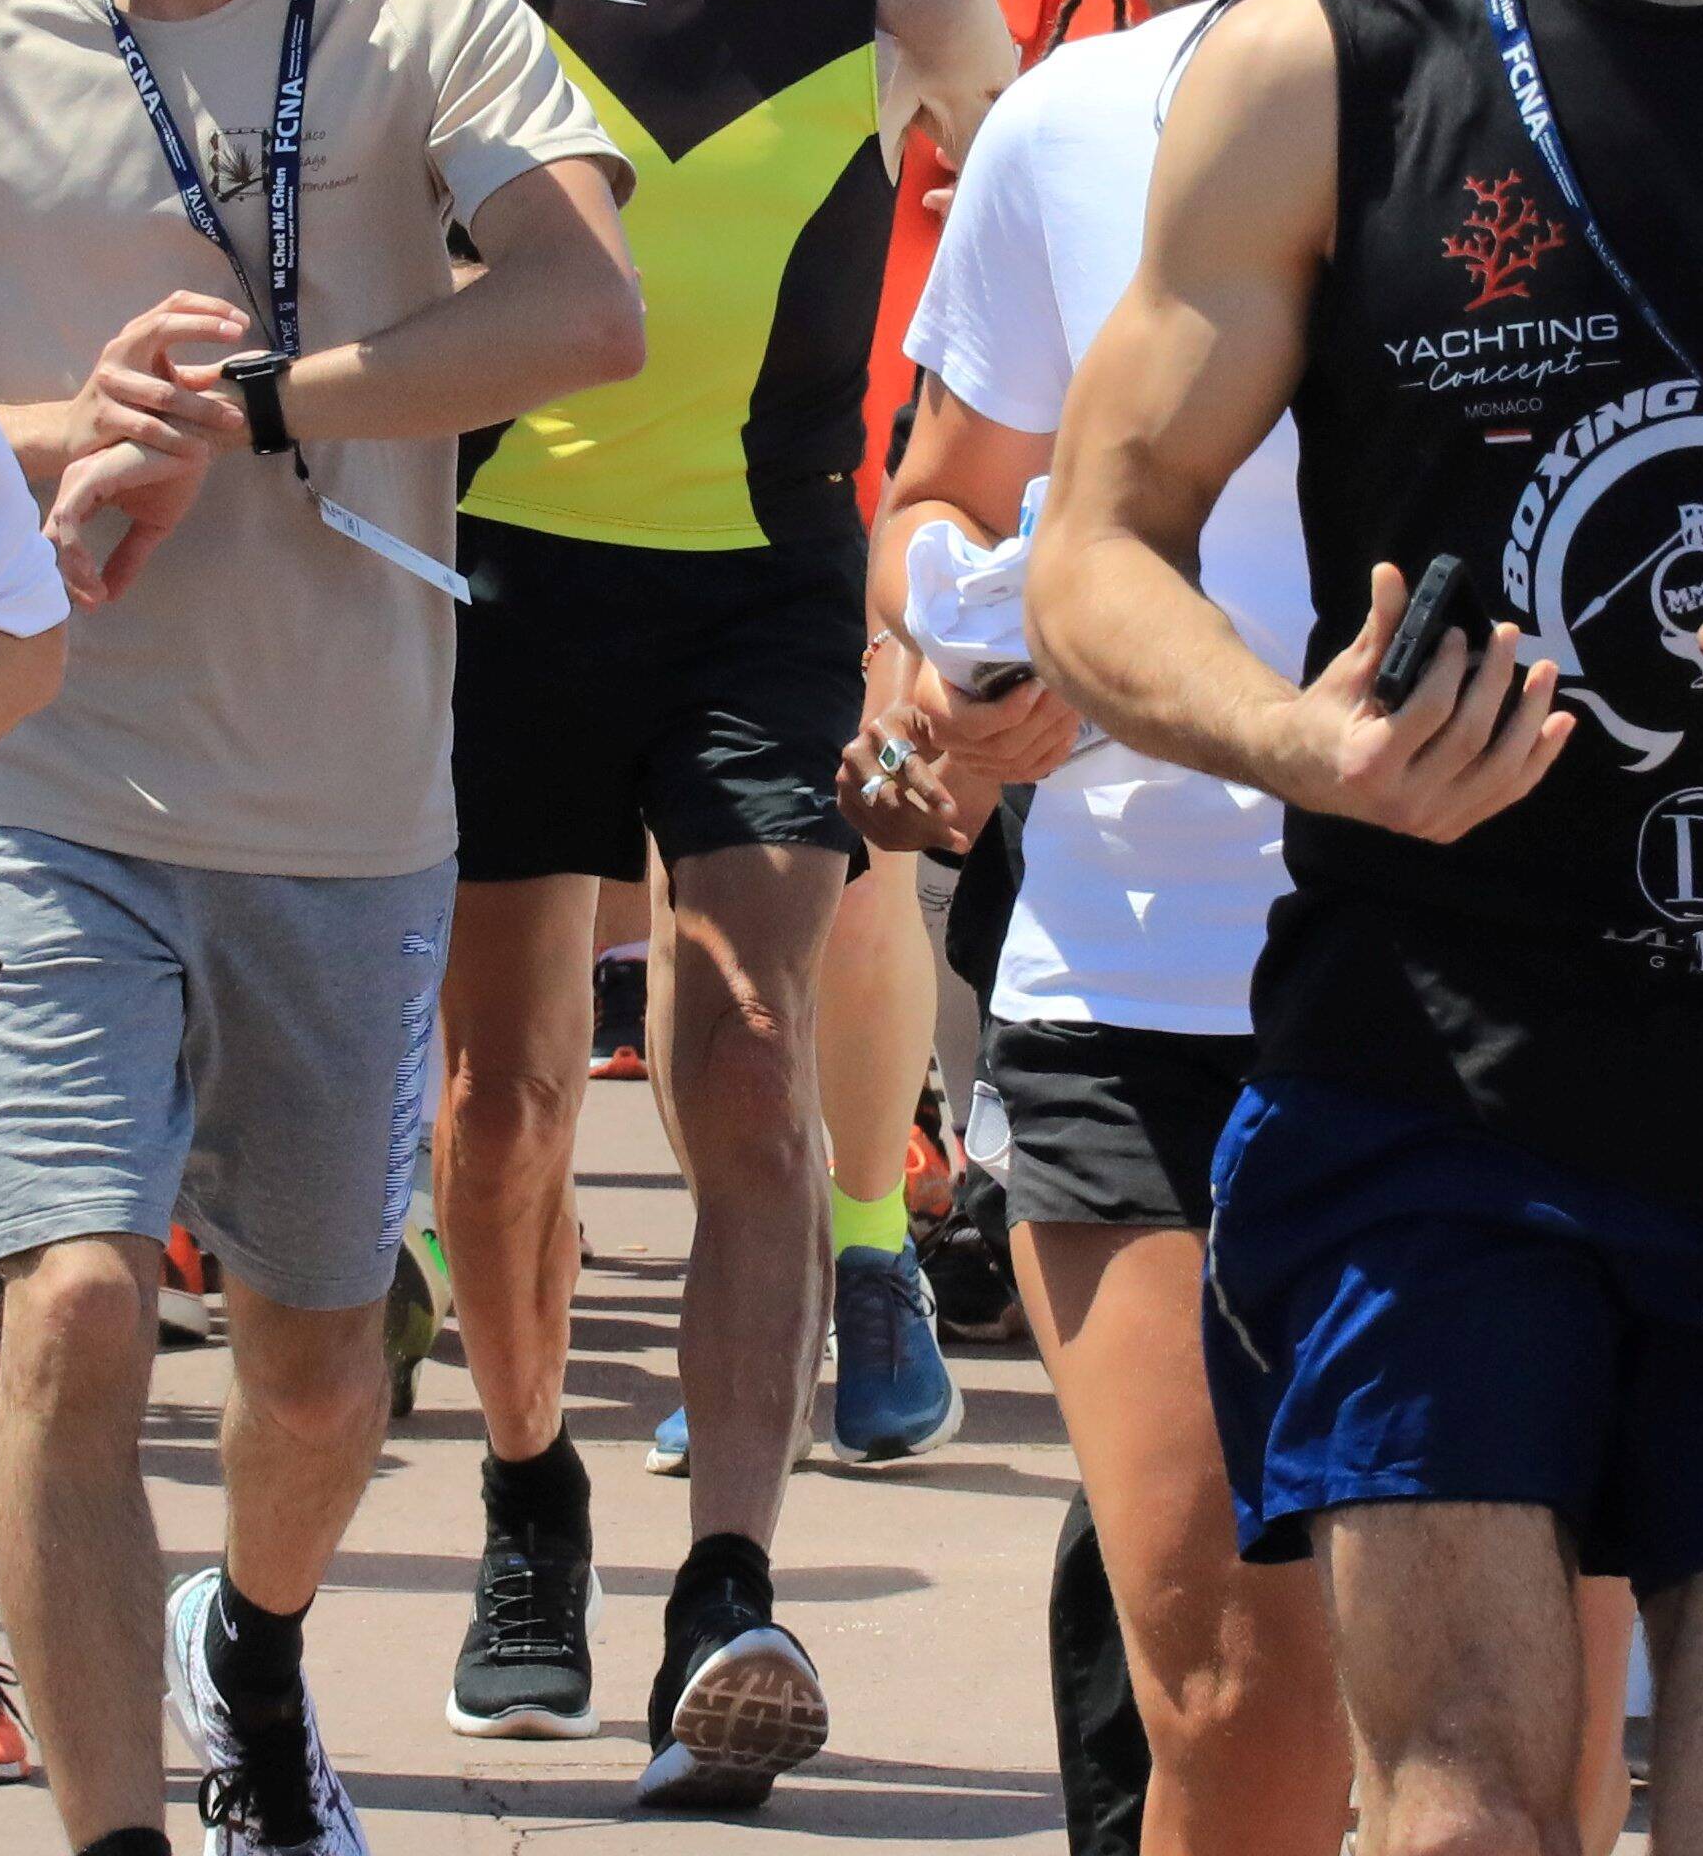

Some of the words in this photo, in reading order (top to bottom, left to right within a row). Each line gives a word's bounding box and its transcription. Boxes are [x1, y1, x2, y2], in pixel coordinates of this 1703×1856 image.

[119, 36, 161, 114] FCNA
[1502, 41, 1550, 142] FCNA
[275, 77, 303, 153] FCNA
[273, 166, 286, 207] Chien
[273, 209, 285, 229] Mi
[273, 231, 285, 266] Chat
[273, 268, 286, 289] Mi
[1383, 313, 1620, 366] YACHTING
[1427, 346, 1583, 391] Concept
[1464, 397, 1544, 419] MONACO
